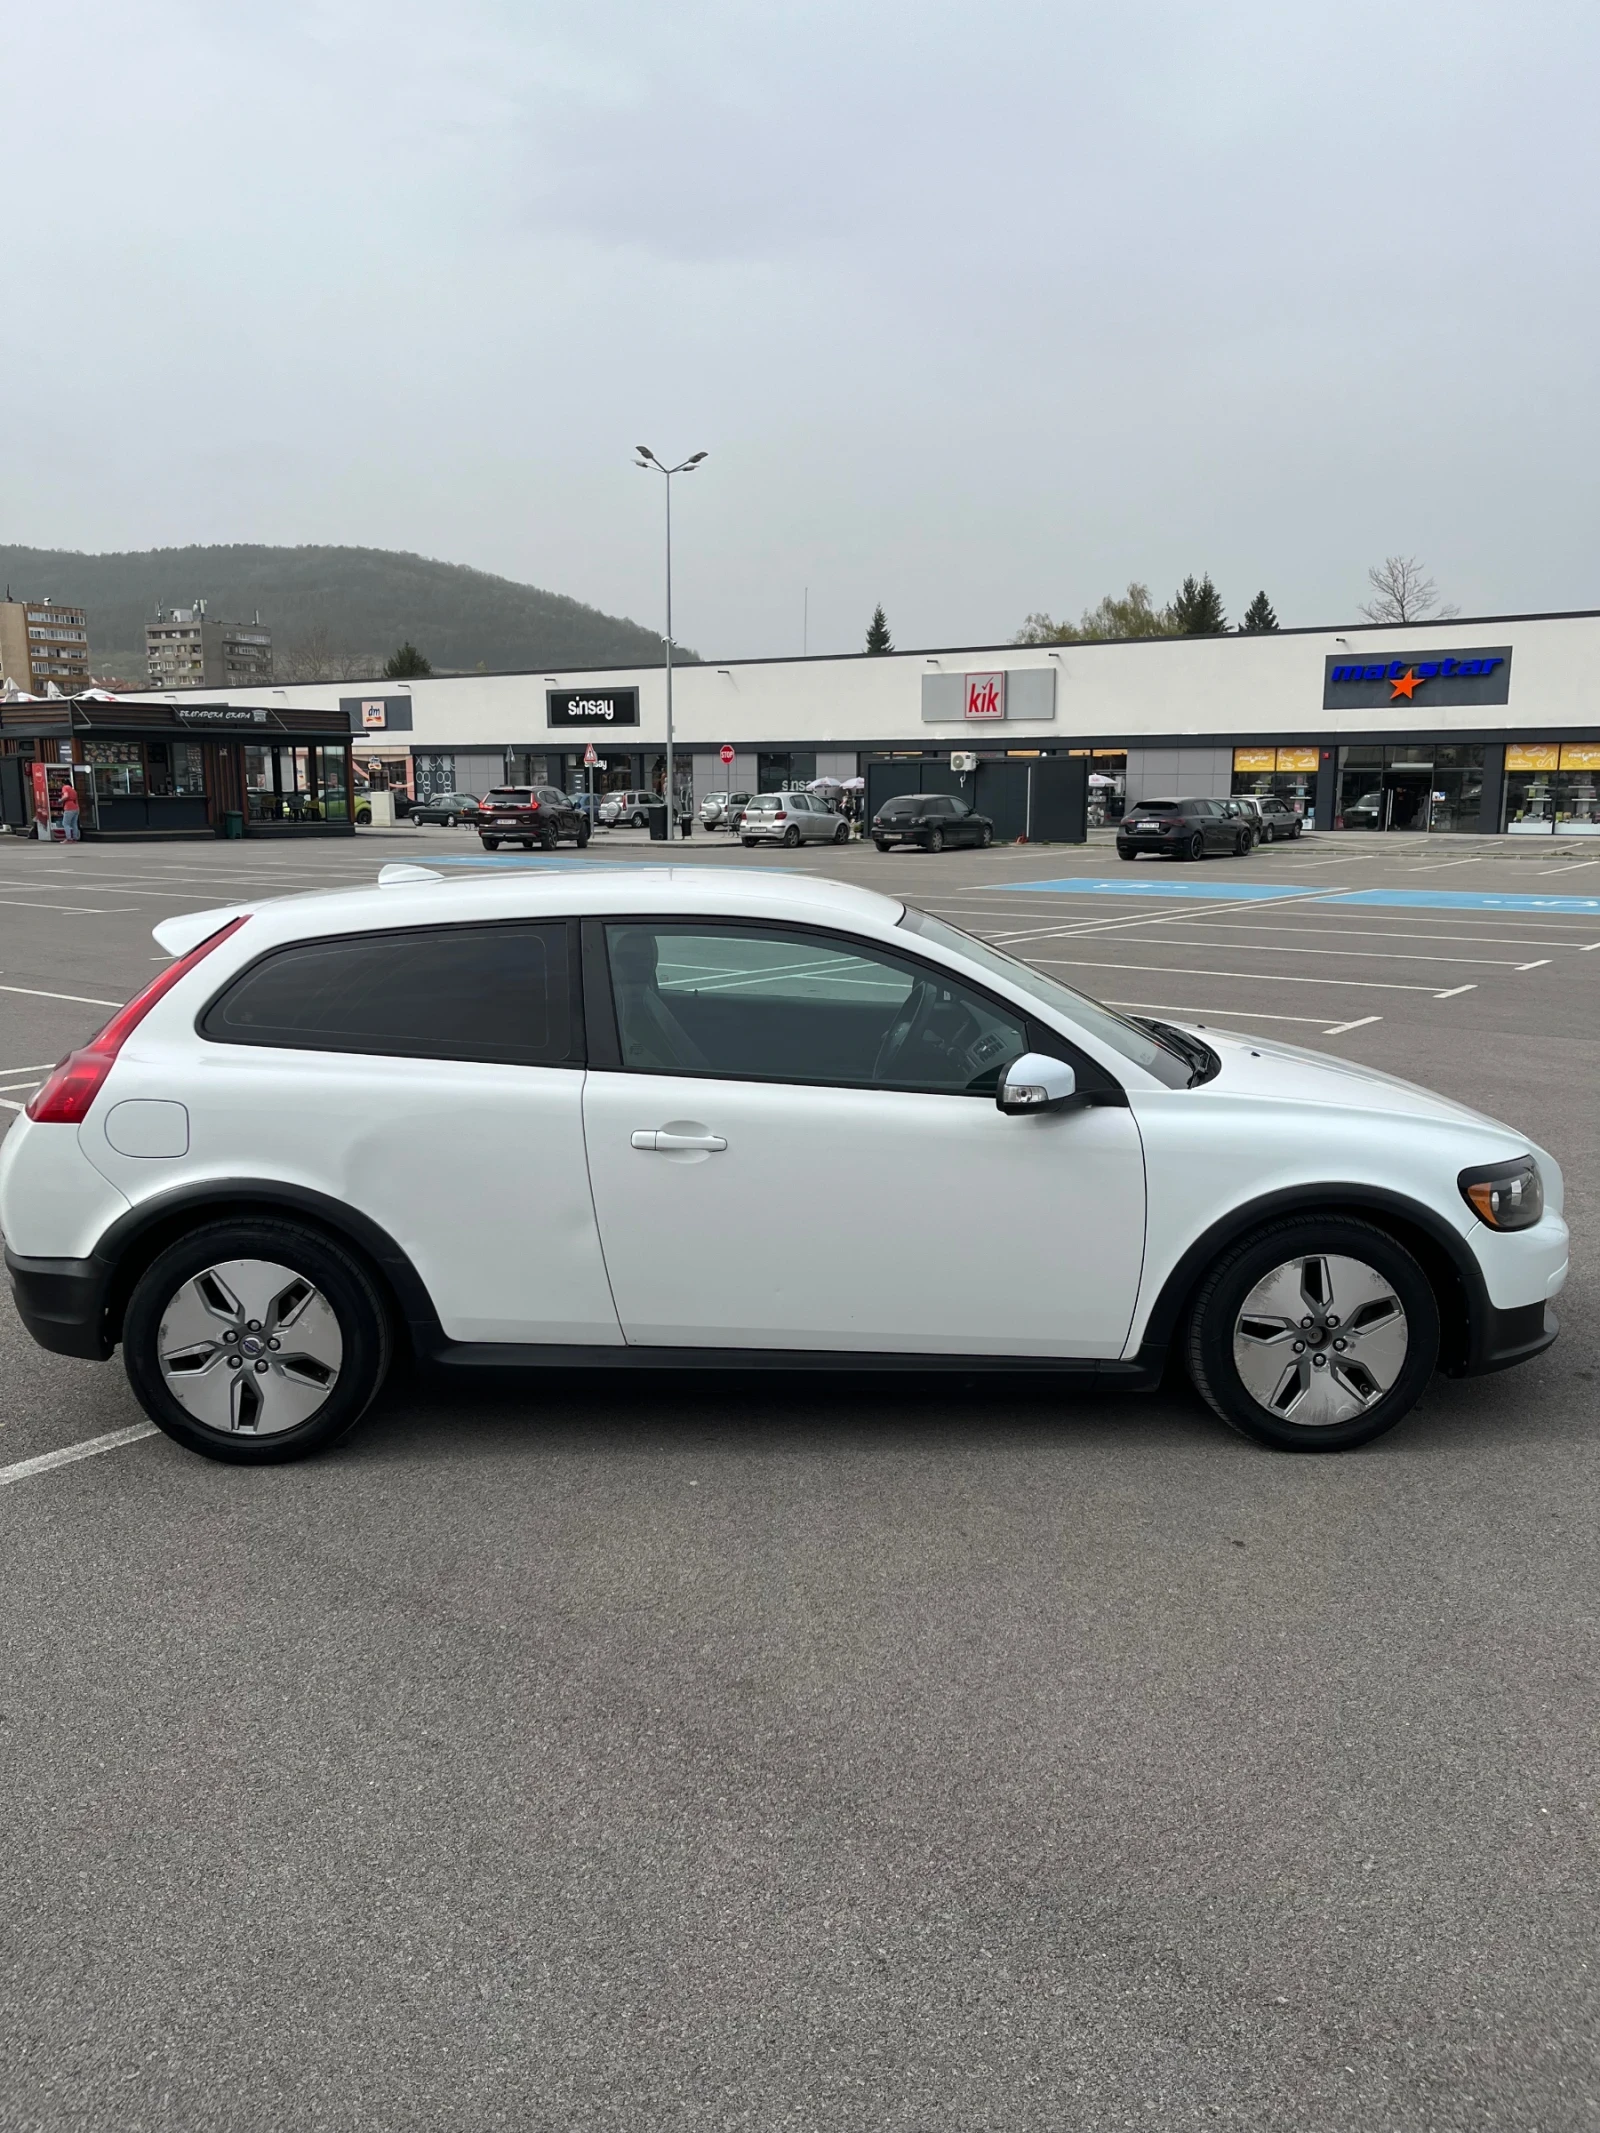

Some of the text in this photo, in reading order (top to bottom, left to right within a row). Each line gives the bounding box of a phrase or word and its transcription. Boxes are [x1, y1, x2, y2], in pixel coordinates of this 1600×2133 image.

[1331, 657, 1504, 682] mat star
[368, 705, 380, 716] dm
[568, 696, 614, 720] sinsay
[721, 751, 734, 759] STOP
